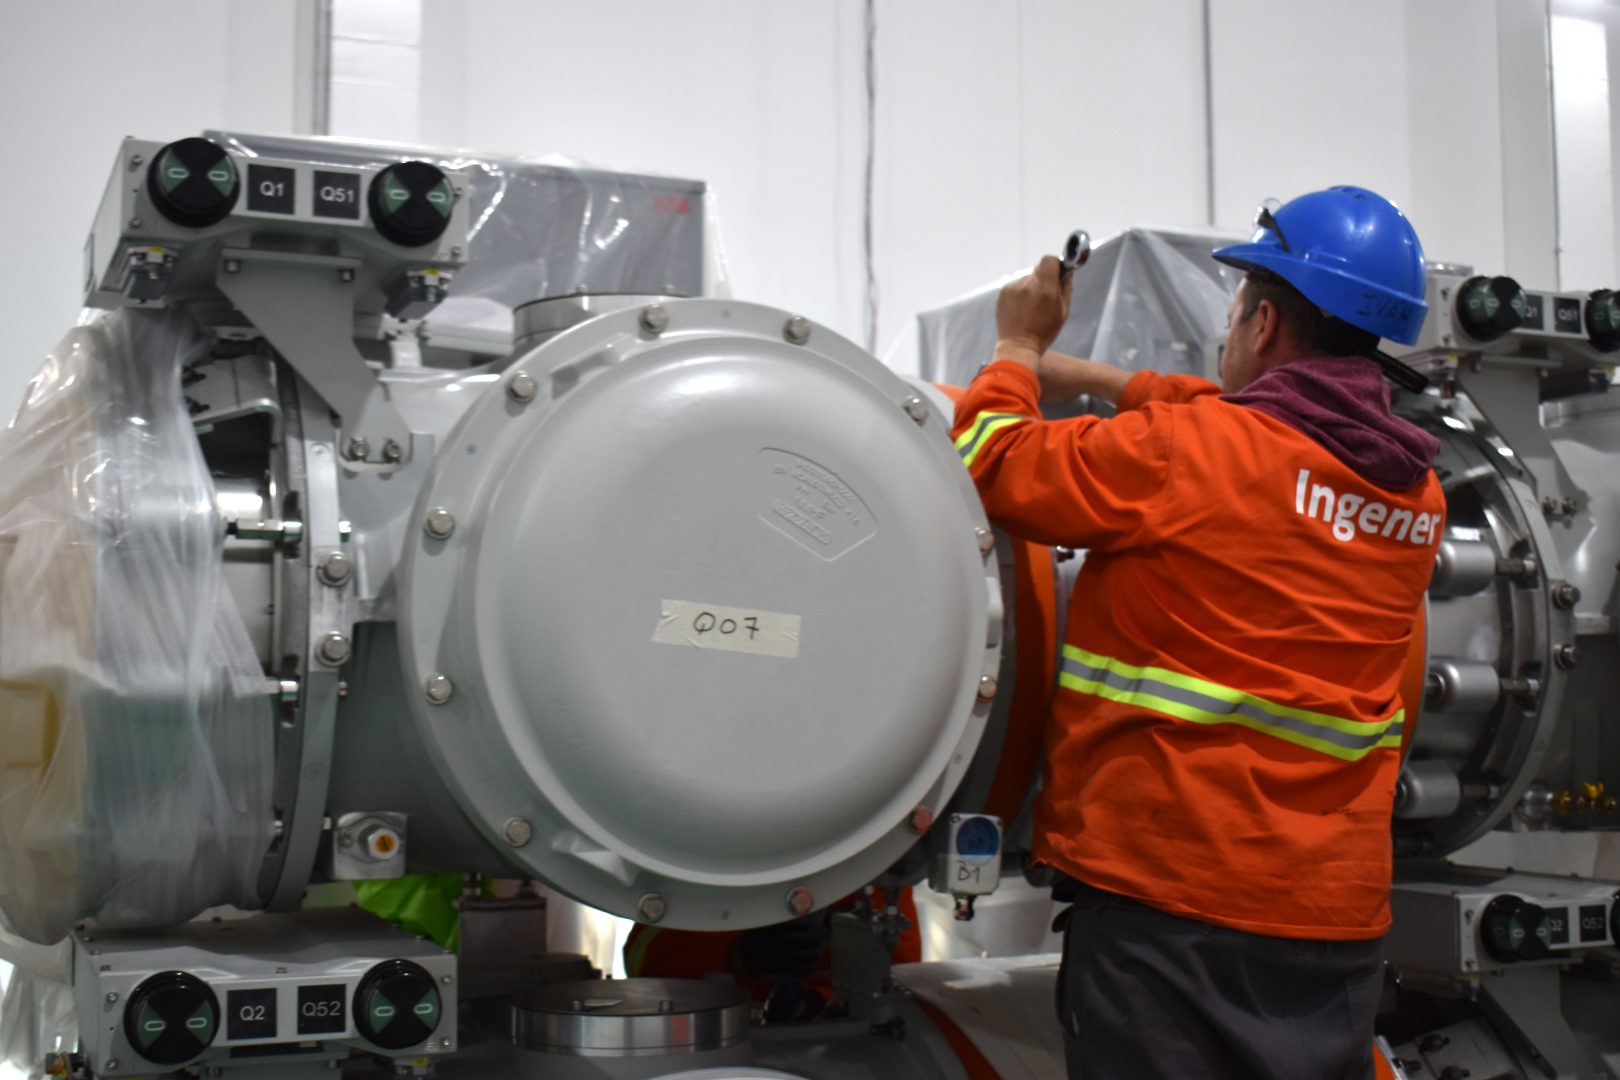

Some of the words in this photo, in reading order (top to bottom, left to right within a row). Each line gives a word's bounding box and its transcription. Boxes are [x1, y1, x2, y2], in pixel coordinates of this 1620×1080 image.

[260, 181, 285, 198] Q1
[320, 185, 355, 203] Q51
[1558, 307, 1577, 321] Q51
[1295, 468, 1441, 544] Ingener
[1582, 916, 1604, 930] Q52
[239, 1005, 266, 1021] Q2
[302, 1001, 341, 1017] Q52
